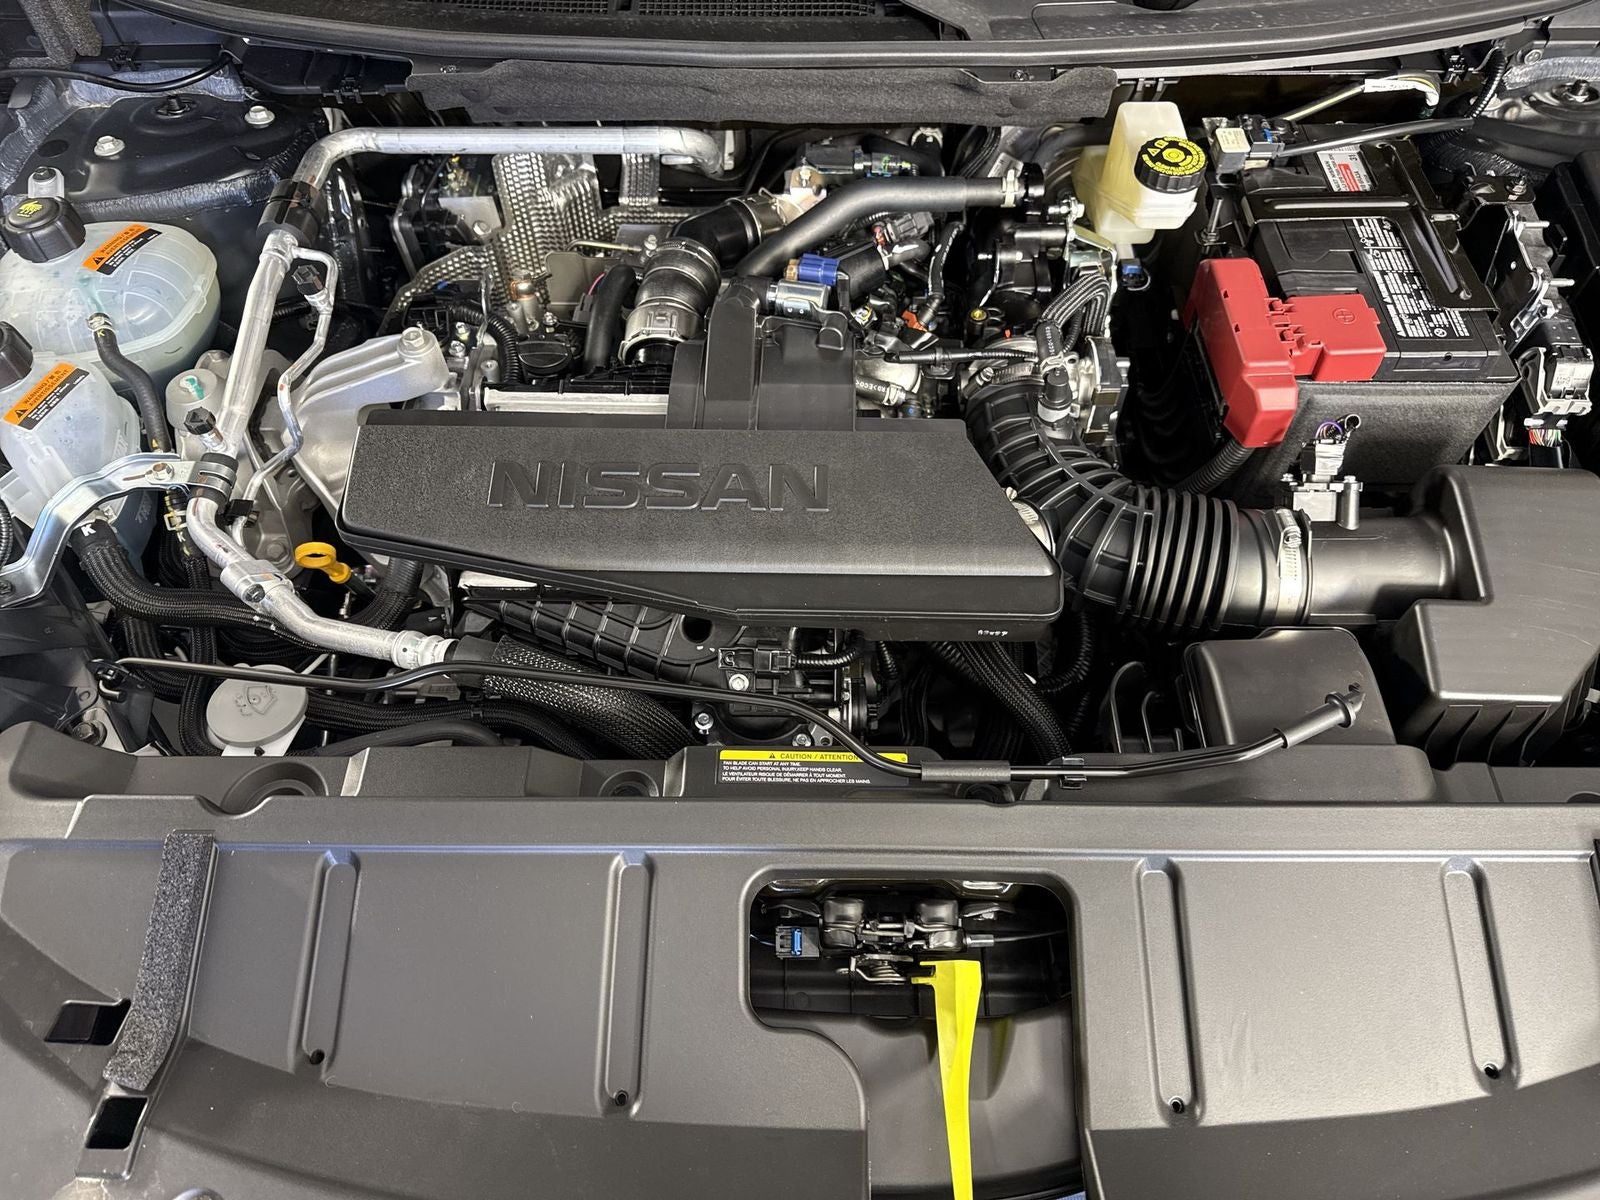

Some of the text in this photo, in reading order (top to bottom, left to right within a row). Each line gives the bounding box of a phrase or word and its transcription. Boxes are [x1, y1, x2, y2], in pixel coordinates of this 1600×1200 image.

[487, 460, 830, 512] NISSAN
[80, 523, 97, 537] K
[780, 752, 812, 760] CAUTION
[819, 753, 859, 761] ATTENTION
